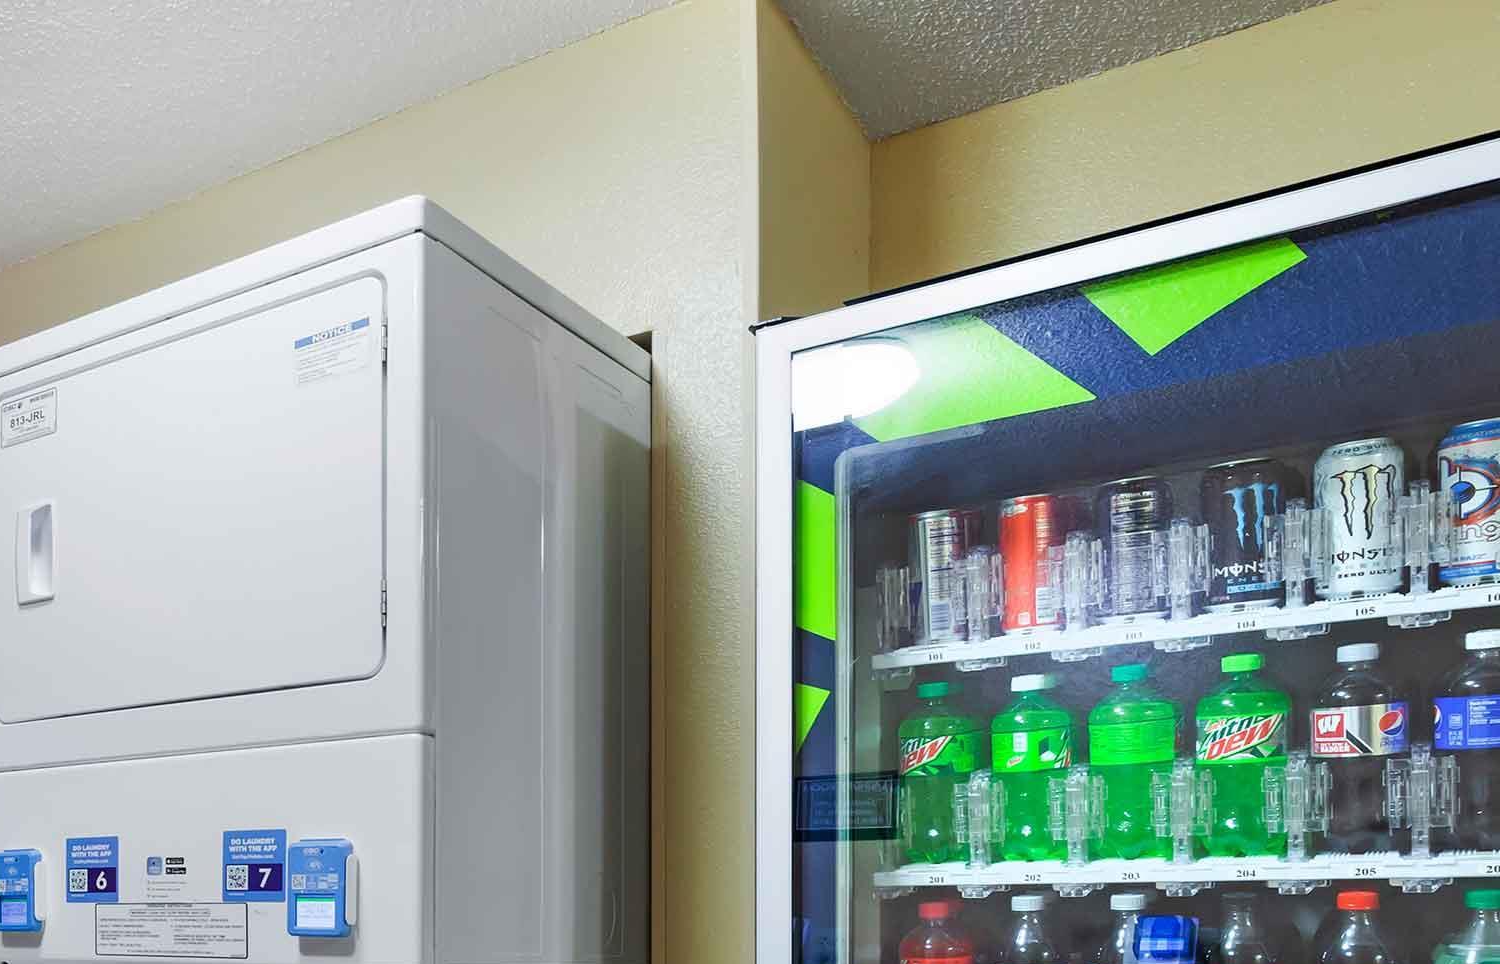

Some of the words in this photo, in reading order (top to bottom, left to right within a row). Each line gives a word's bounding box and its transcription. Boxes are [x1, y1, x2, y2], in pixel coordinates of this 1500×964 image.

[10, 409, 45, 429] 813-JRL
[1487, 593, 1500, 602] 10
[1355, 606, 1377, 616] 105
[1236, 620, 1256, 629] 104
[1025, 641, 1041, 650] 102
[231, 838, 241, 846] DO
[242, 837, 275, 846] LAUNDRY
[1236, 869, 1256, 878] 204
[1355, 867, 1377, 876] 205
[1485, 865, 1500, 874] 20
[96, 871, 108, 890] 6
[258, 868, 272, 888] 7
[929, 876, 945, 884] 201
[1025, 874, 1041, 882] 202
[1122, 872, 1141, 880] 203
